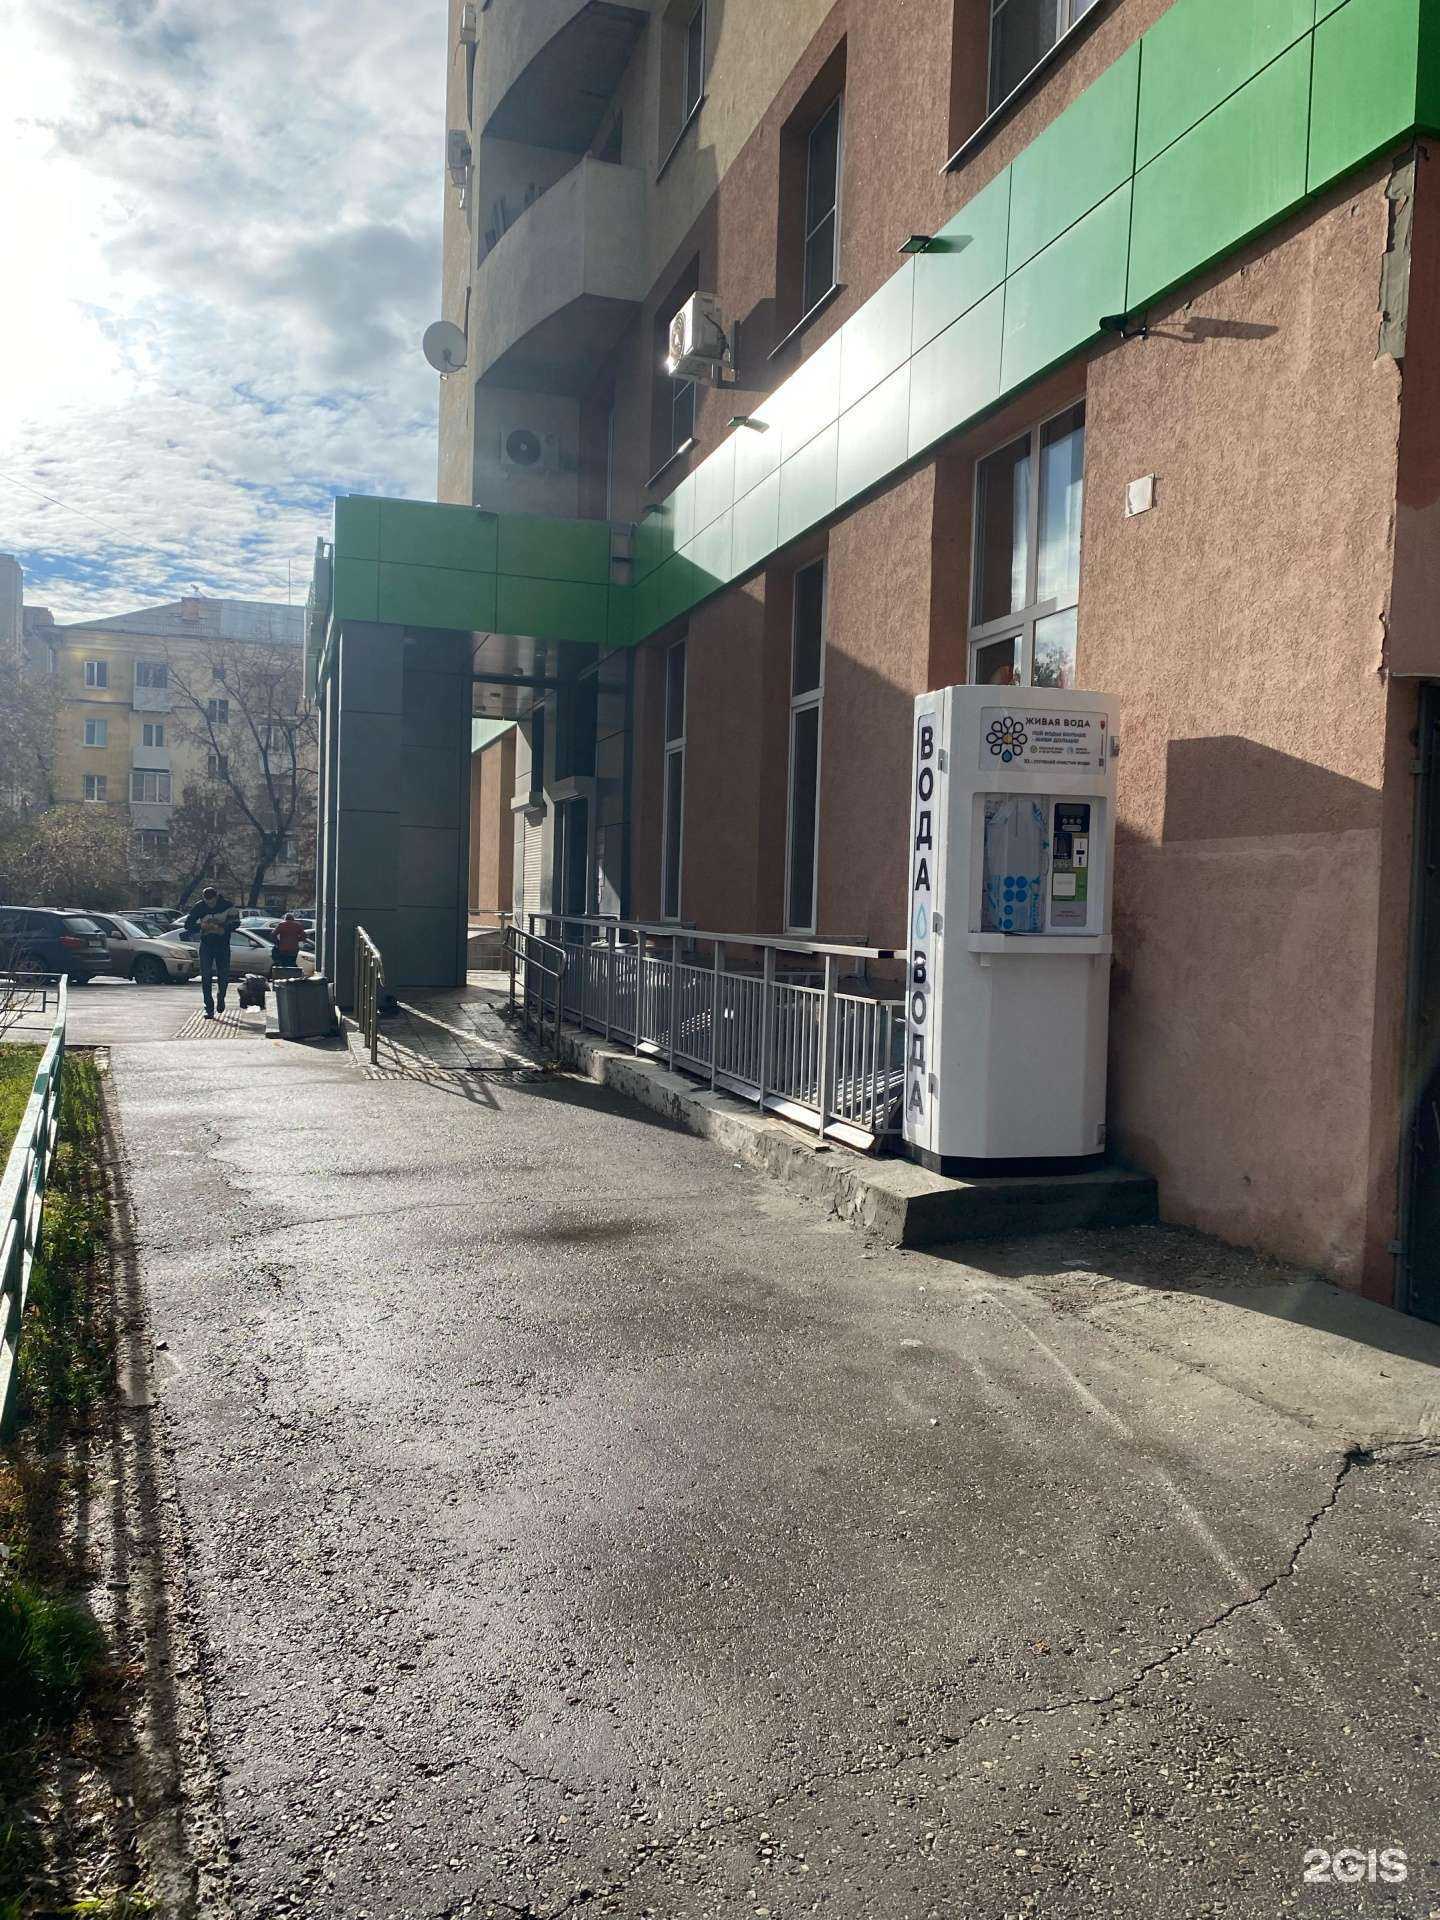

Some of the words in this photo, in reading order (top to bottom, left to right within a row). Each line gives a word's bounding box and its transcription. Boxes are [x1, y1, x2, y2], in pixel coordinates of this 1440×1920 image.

[1025, 717, 1061, 727] ЖИВАЯ
[1064, 719, 1091, 729] ВОДА
[914, 725, 934, 892] ВОДА
[908, 950, 927, 1116] ВОДА
